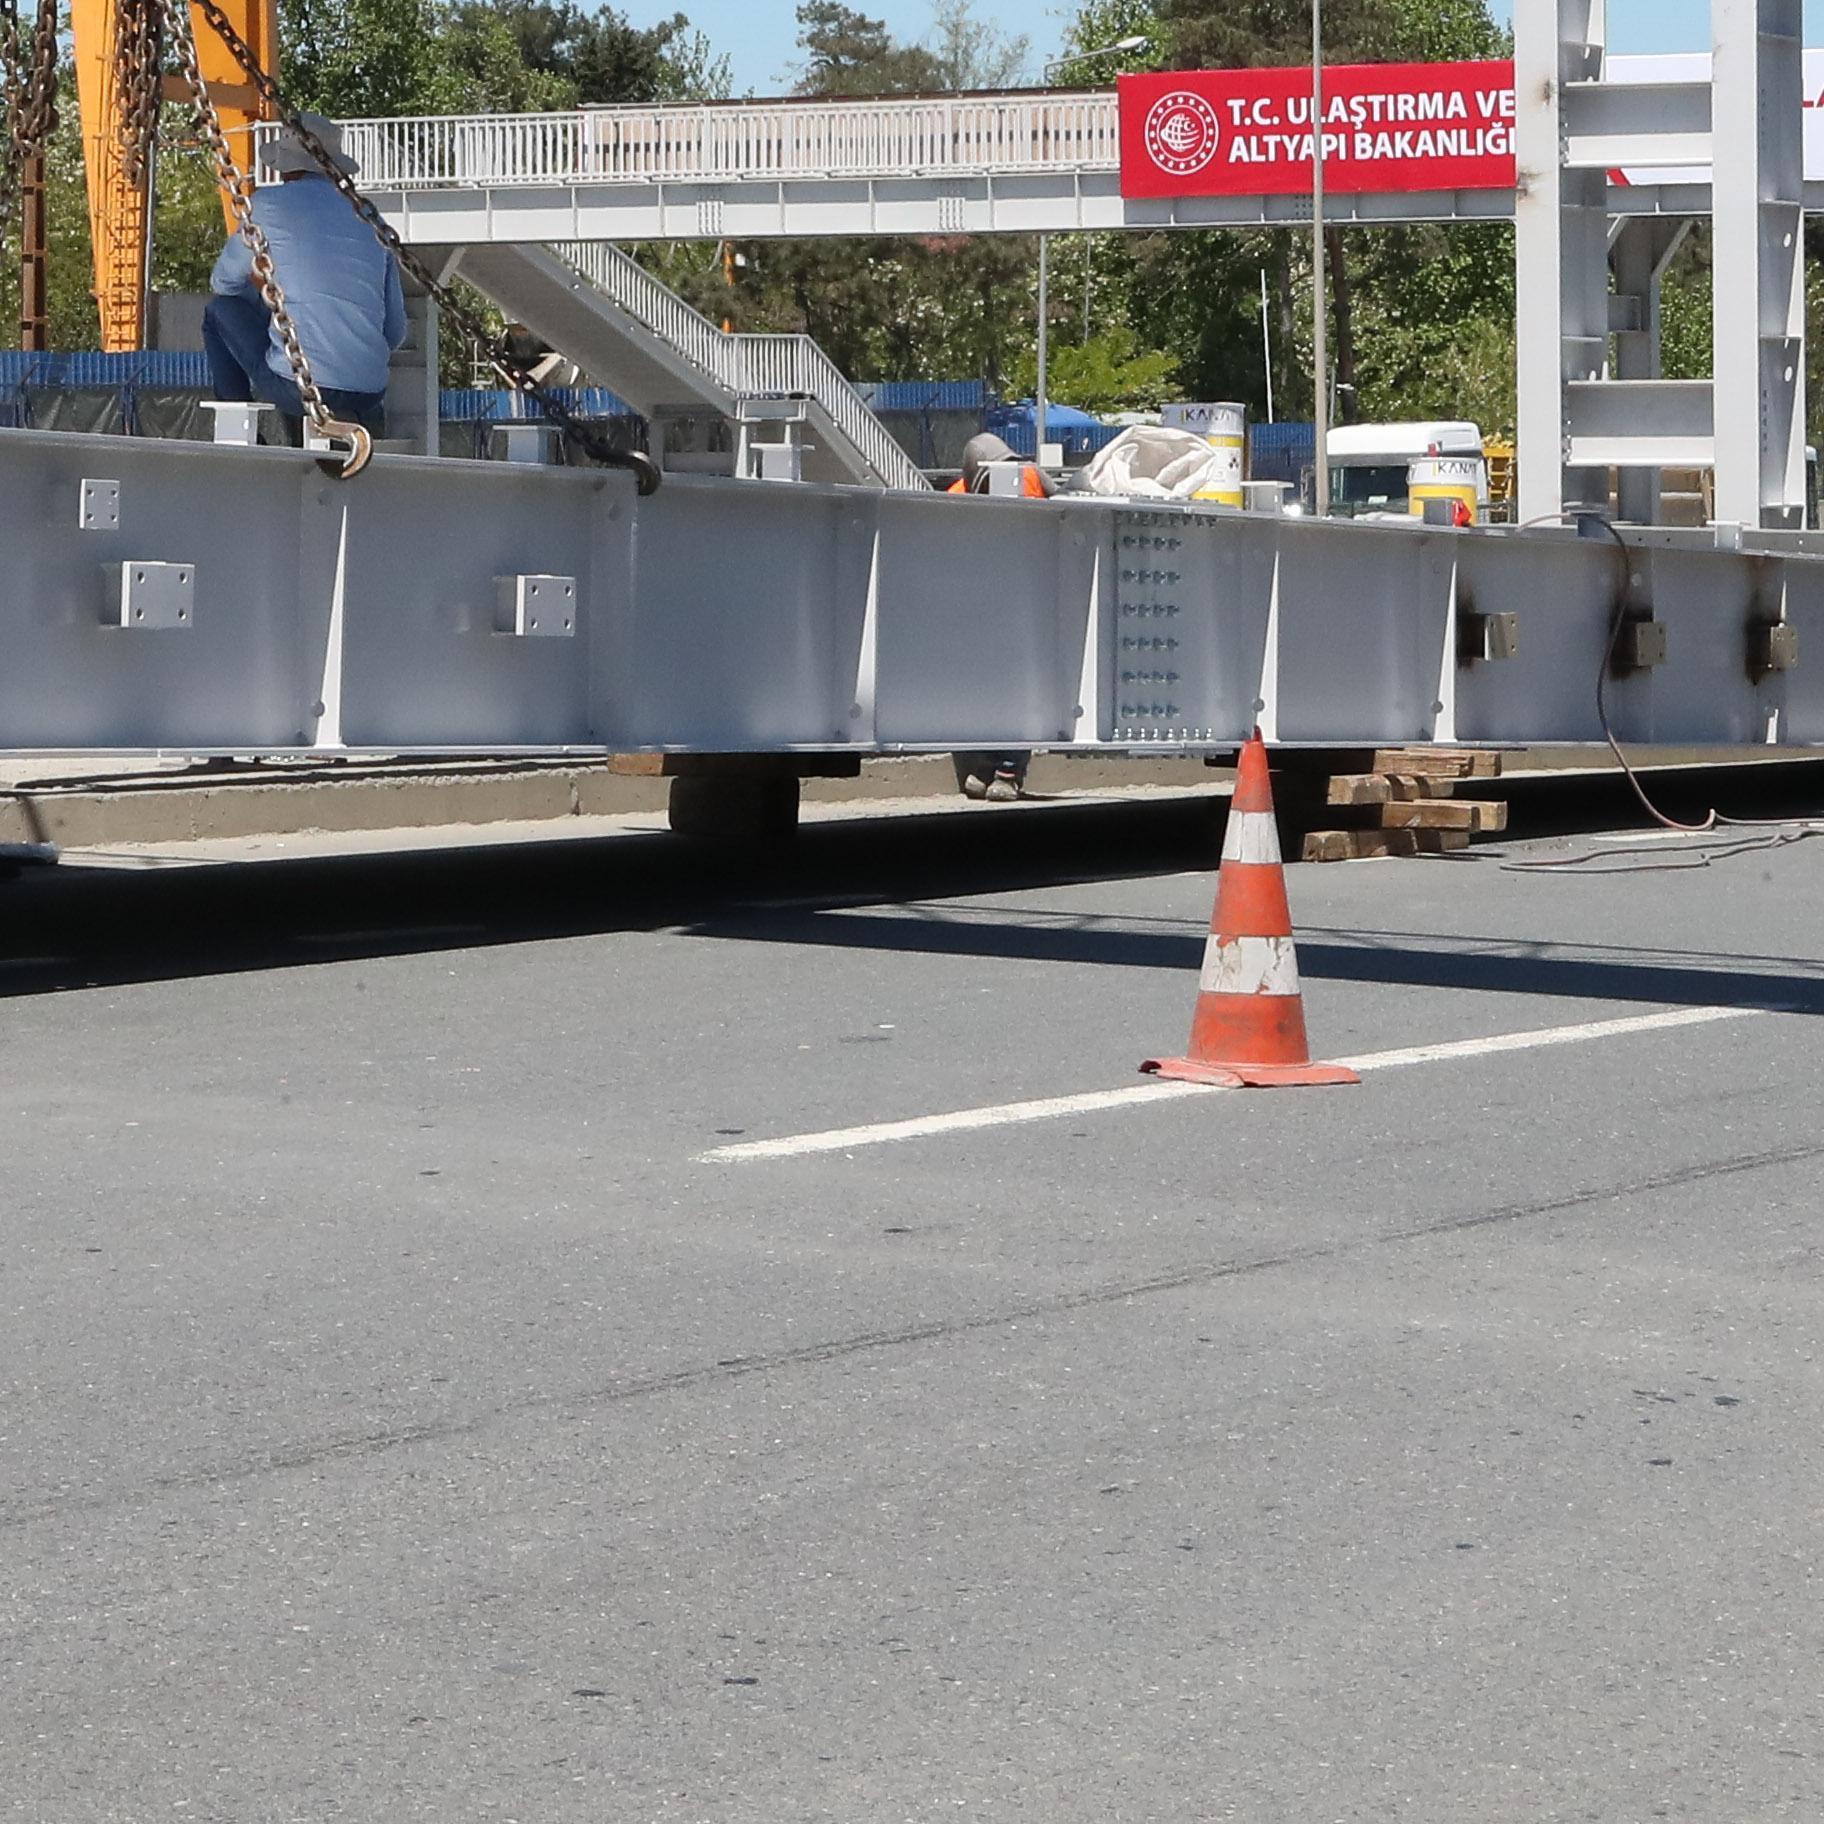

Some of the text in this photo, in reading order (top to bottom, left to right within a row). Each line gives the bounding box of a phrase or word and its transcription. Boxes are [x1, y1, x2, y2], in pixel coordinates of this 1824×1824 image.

[1227, 99, 1280, 127] T.C.
[1475, 89, 1516, 118] VE
[1228, 121, 1516, 164] ALTYAPI BAKANLIĞI
